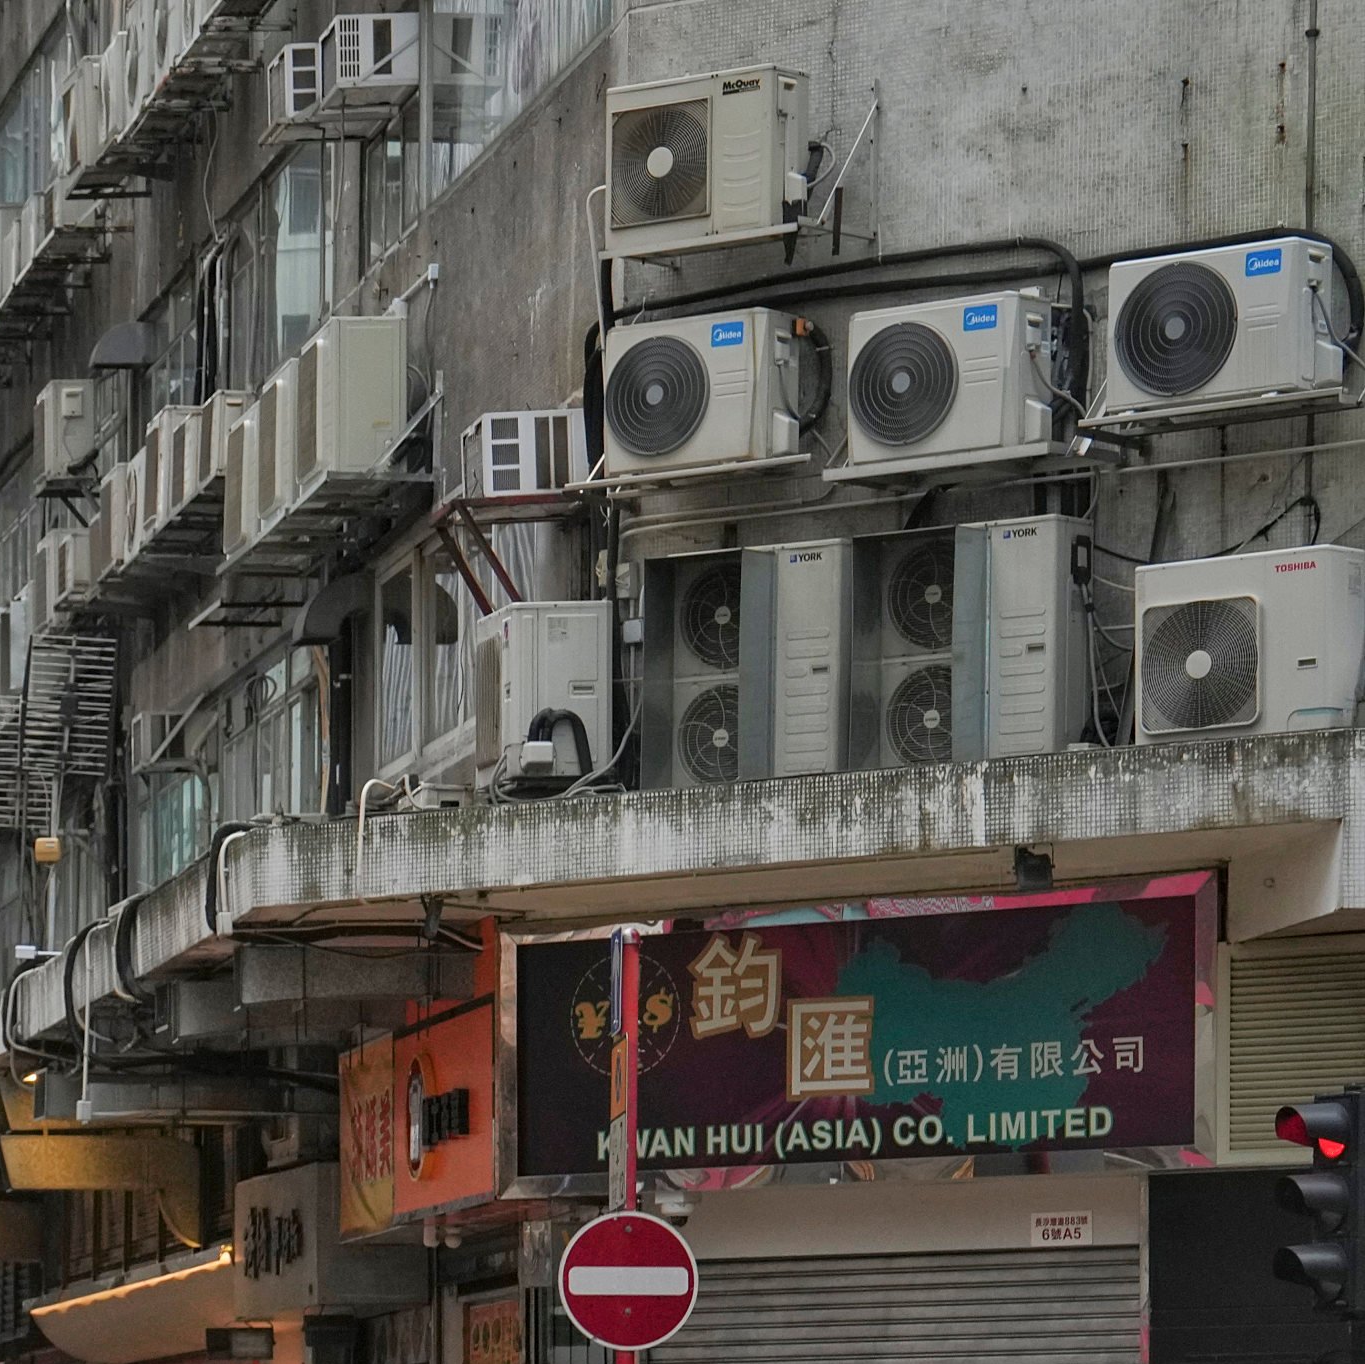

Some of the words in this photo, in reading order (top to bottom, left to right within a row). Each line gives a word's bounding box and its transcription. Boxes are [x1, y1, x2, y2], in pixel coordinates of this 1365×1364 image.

[722, 79, 761, 91] McQuay
[1011, 527, 1038, 538] YORK
[798, 551, 823, 563] YORK
[1274, 561, 1317, 573] TOSHIBA
[883, 1035, 1145, 1087] (亞洲)有限公司
[706, 1122, 764, 1156] HUI
[774, 1117, 882, 1159] (ASIA)
[892, 1113, 954, 1146] CO.
[966, 1105, 1114, 1143] LIMITED
